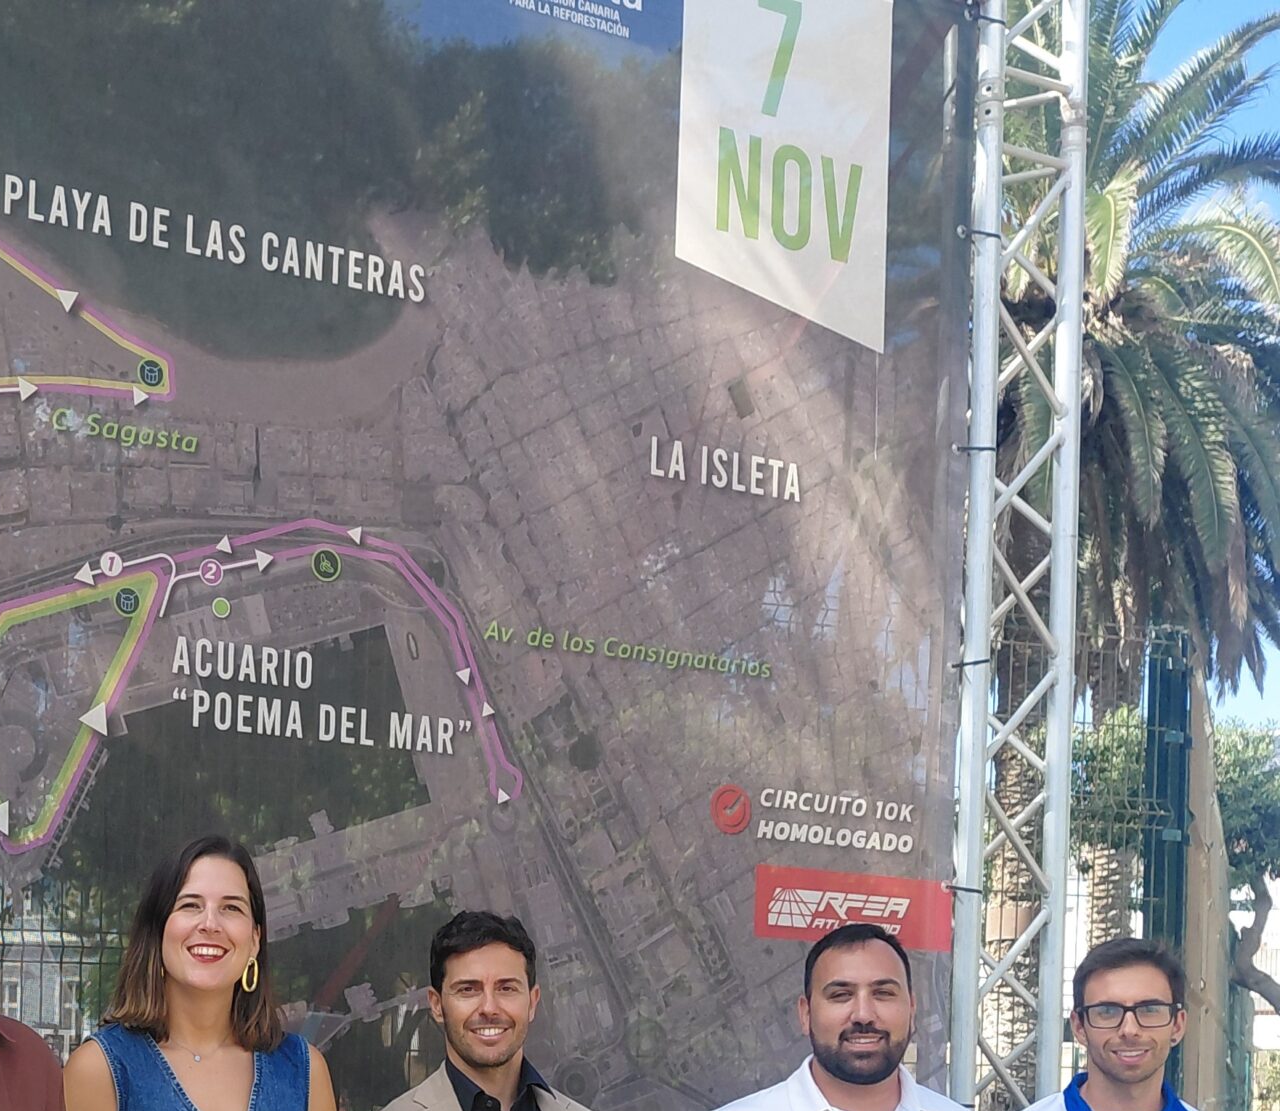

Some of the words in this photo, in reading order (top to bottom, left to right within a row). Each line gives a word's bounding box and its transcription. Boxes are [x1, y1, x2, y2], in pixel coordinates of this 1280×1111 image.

[538, 1, 551, 16] LA
[553, 6, 630, 38] REFORESTACIÓN
[578, 0, 621, 20] CANARIA
[758, 0, 802, 117] 7
[715, 126, 864, 264] NOV
[3, 173, 112, 236] PLAYA
[129, 201, 171, 249] DE
[185, 213, 246, 265] LAS
[261, 231, 426, 302] CANTERAS
[87, 413, 197, 453] Sagasta
[650, 436, 686, 481] LA
[701, 445, 800, 502] ISLETA
[108, 556, 115, 572] 1
[204, 563, 217, 579] 2
[171, 635, 313, 690] ACUARIO
[484, 620, 518, 644] Av.
[527, 627, 554, 648] de
[562, 631, 595, 654] los
[603, 637, 771, 678] Consignatarios
[318, 704, 374, 747] DEL
[760, 788, 867, 817] CIRCUITO
[875, 801, 915, 823] 10K
[757, 820, 913, 853] HOMOLOGADO
